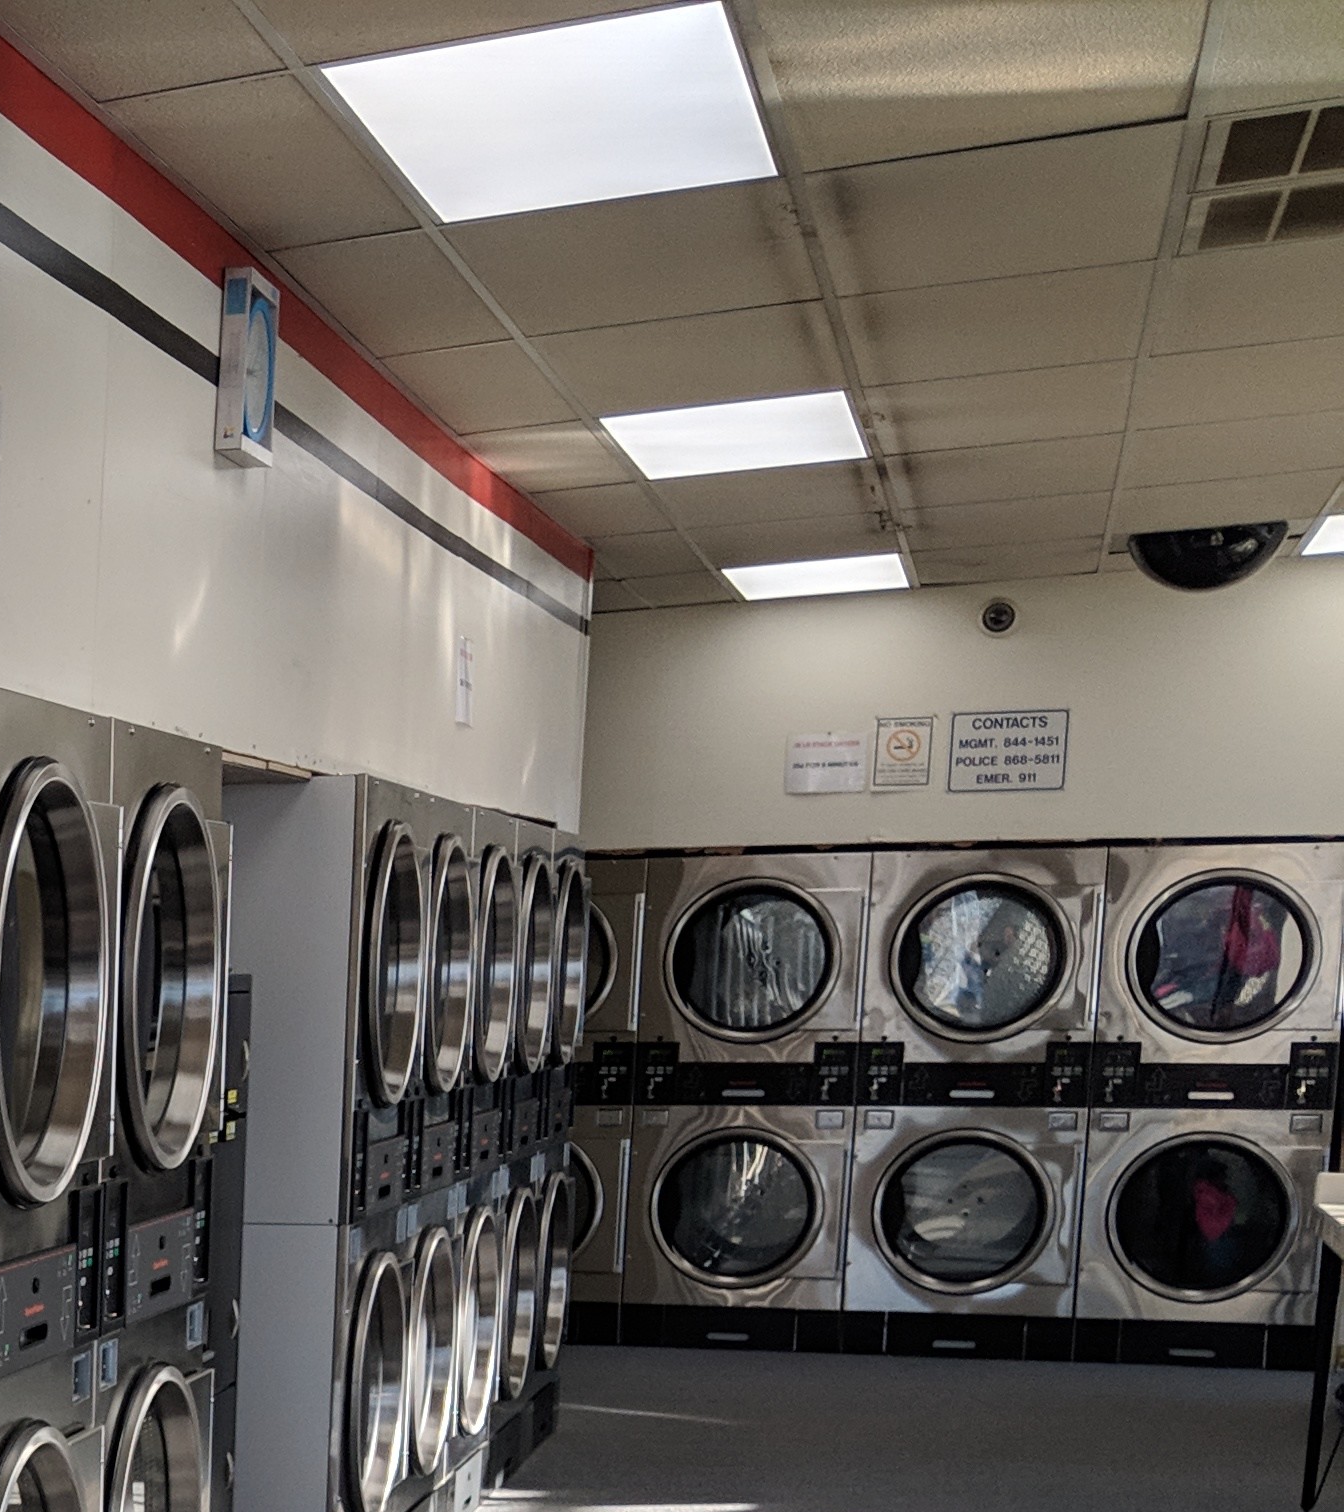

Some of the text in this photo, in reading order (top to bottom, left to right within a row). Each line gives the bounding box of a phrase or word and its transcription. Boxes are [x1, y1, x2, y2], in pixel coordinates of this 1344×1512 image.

[971, 715, 1049, 731] CONTACTS
[958, 735, 1060, 749] MGMT. 844-1451
[955, 753, 1061, 768] POLICE 868-5811
[1018, 772, 1037, 783] 911
